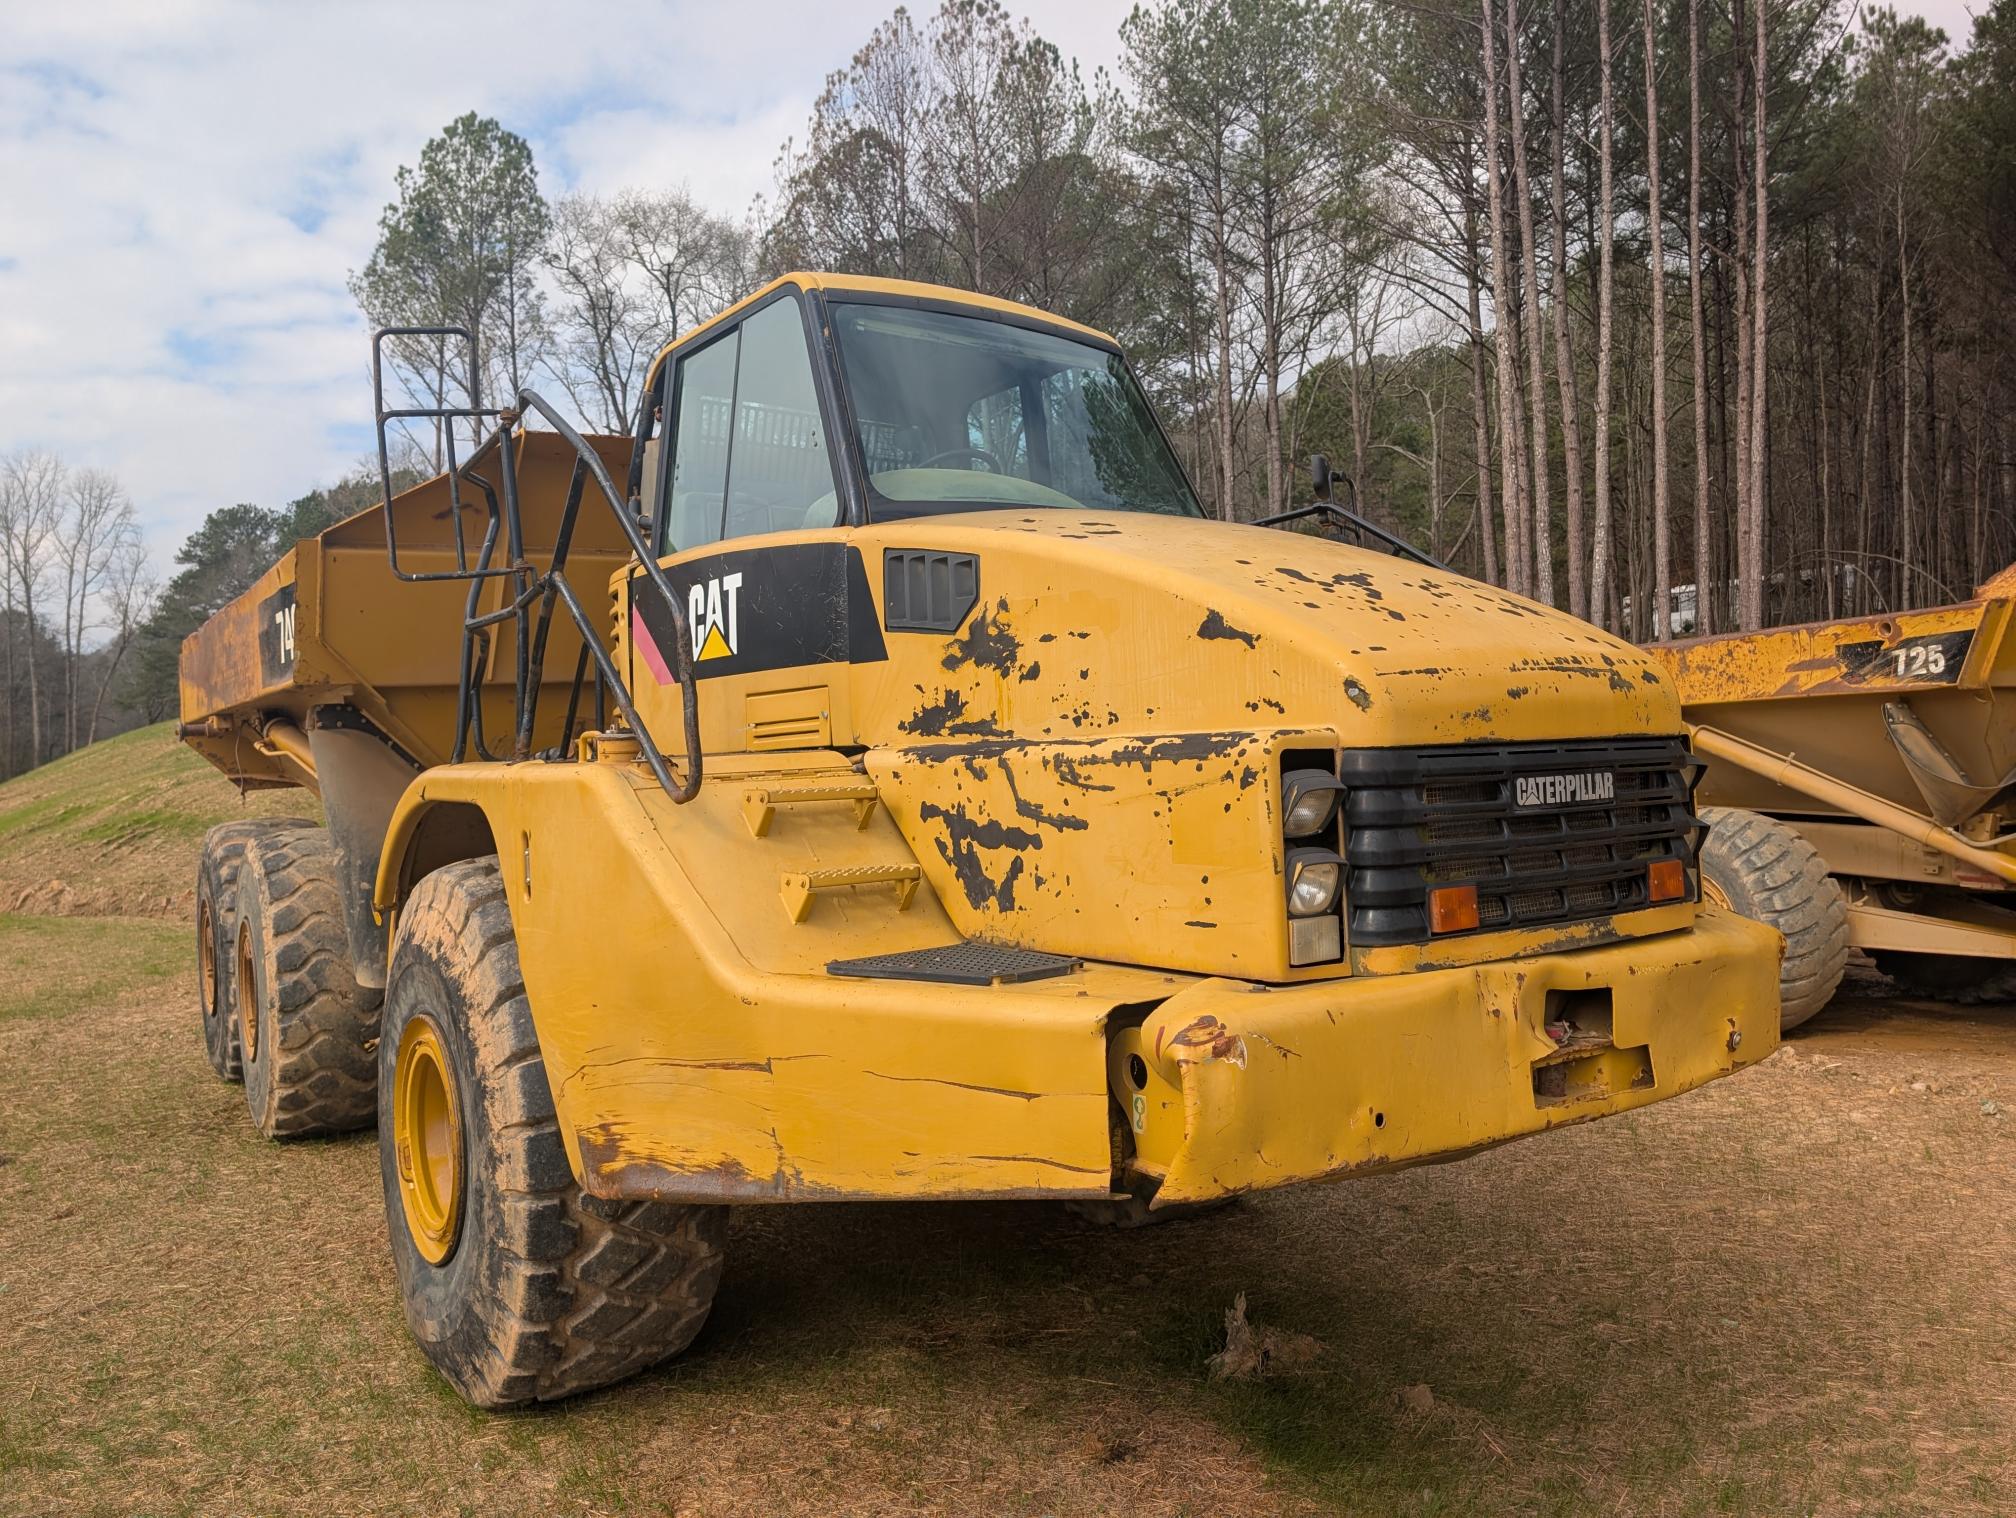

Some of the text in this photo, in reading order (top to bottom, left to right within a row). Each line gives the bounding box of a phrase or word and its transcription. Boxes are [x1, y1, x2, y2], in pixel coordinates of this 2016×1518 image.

[688, 572, 743, 662] CAT
[1891, 643, 1946, 677] 725
[1516, 772, 1615, 806] CATERPILLAR
